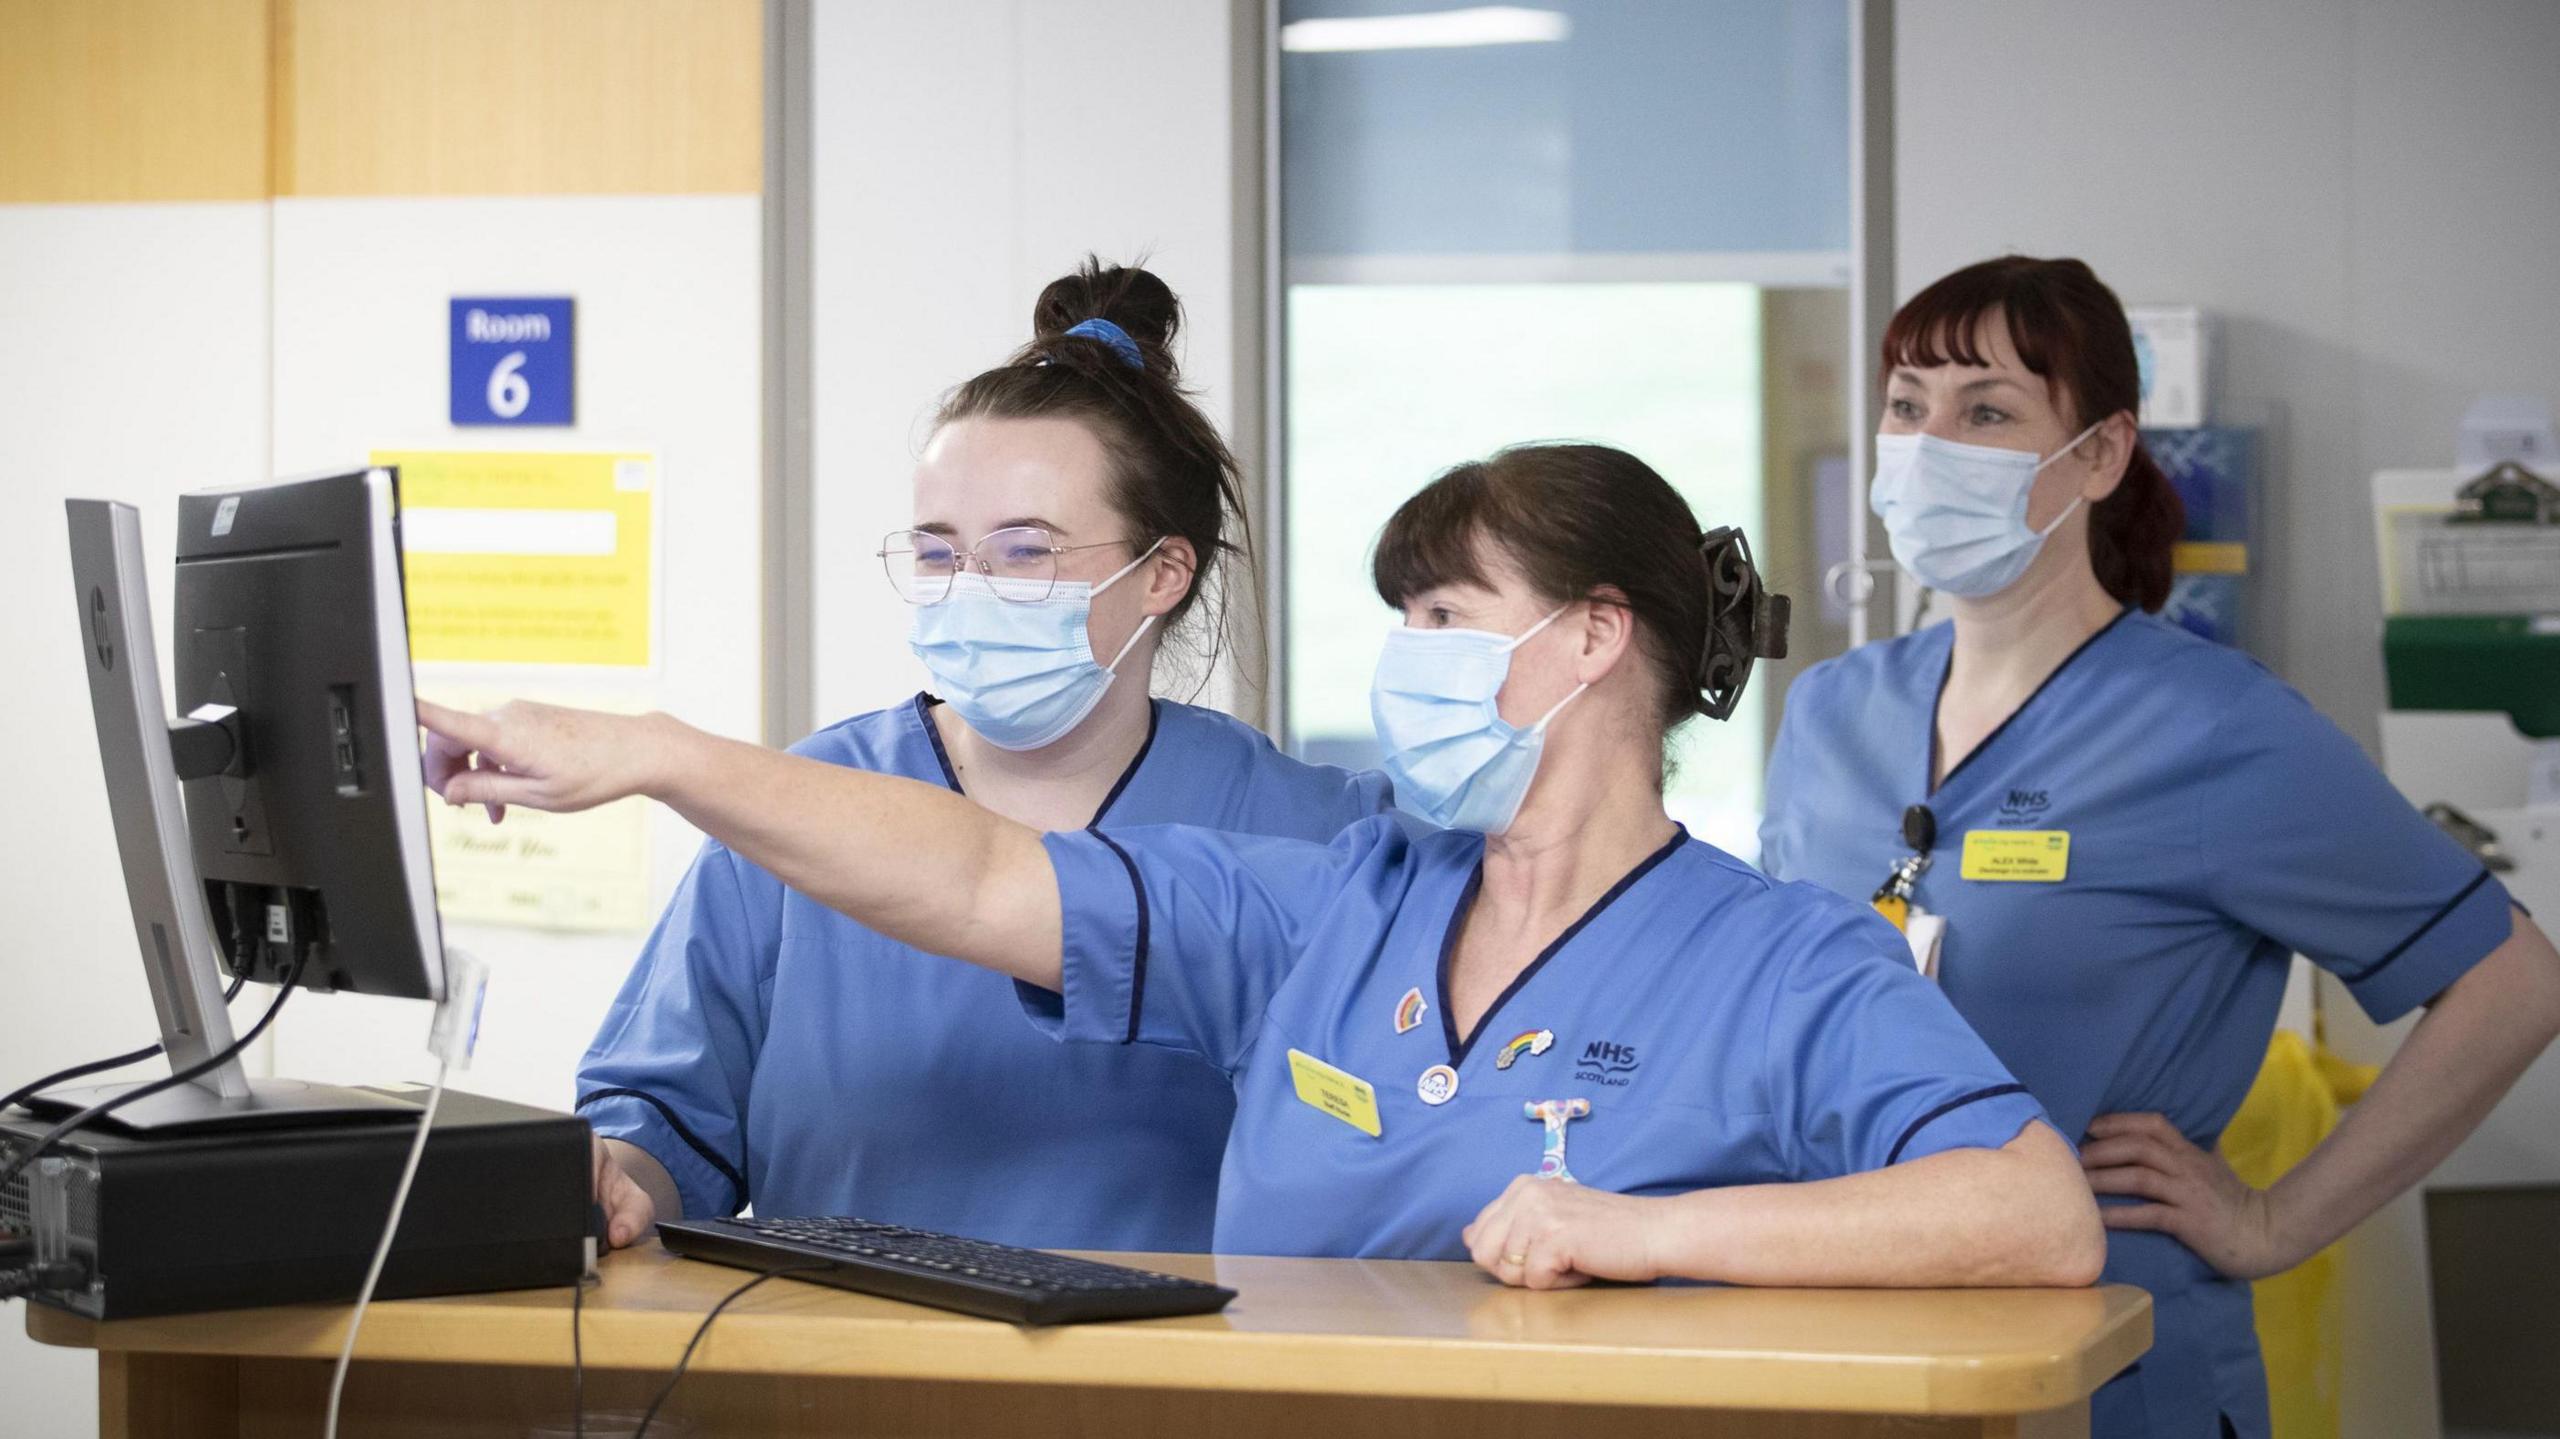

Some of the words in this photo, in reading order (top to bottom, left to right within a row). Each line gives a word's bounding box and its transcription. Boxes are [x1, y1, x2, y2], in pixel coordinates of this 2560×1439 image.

[466, 308, 551, 343] Room
[487, 350, 530, 419] 6
[2007, 790, 2049, 807] NHS
[1584, 1040, 1635, 1065] NHS
[1421, 1076, 1448, 1099] NHS
[1575, 1072, 1630, 1086] SCOTLAND
